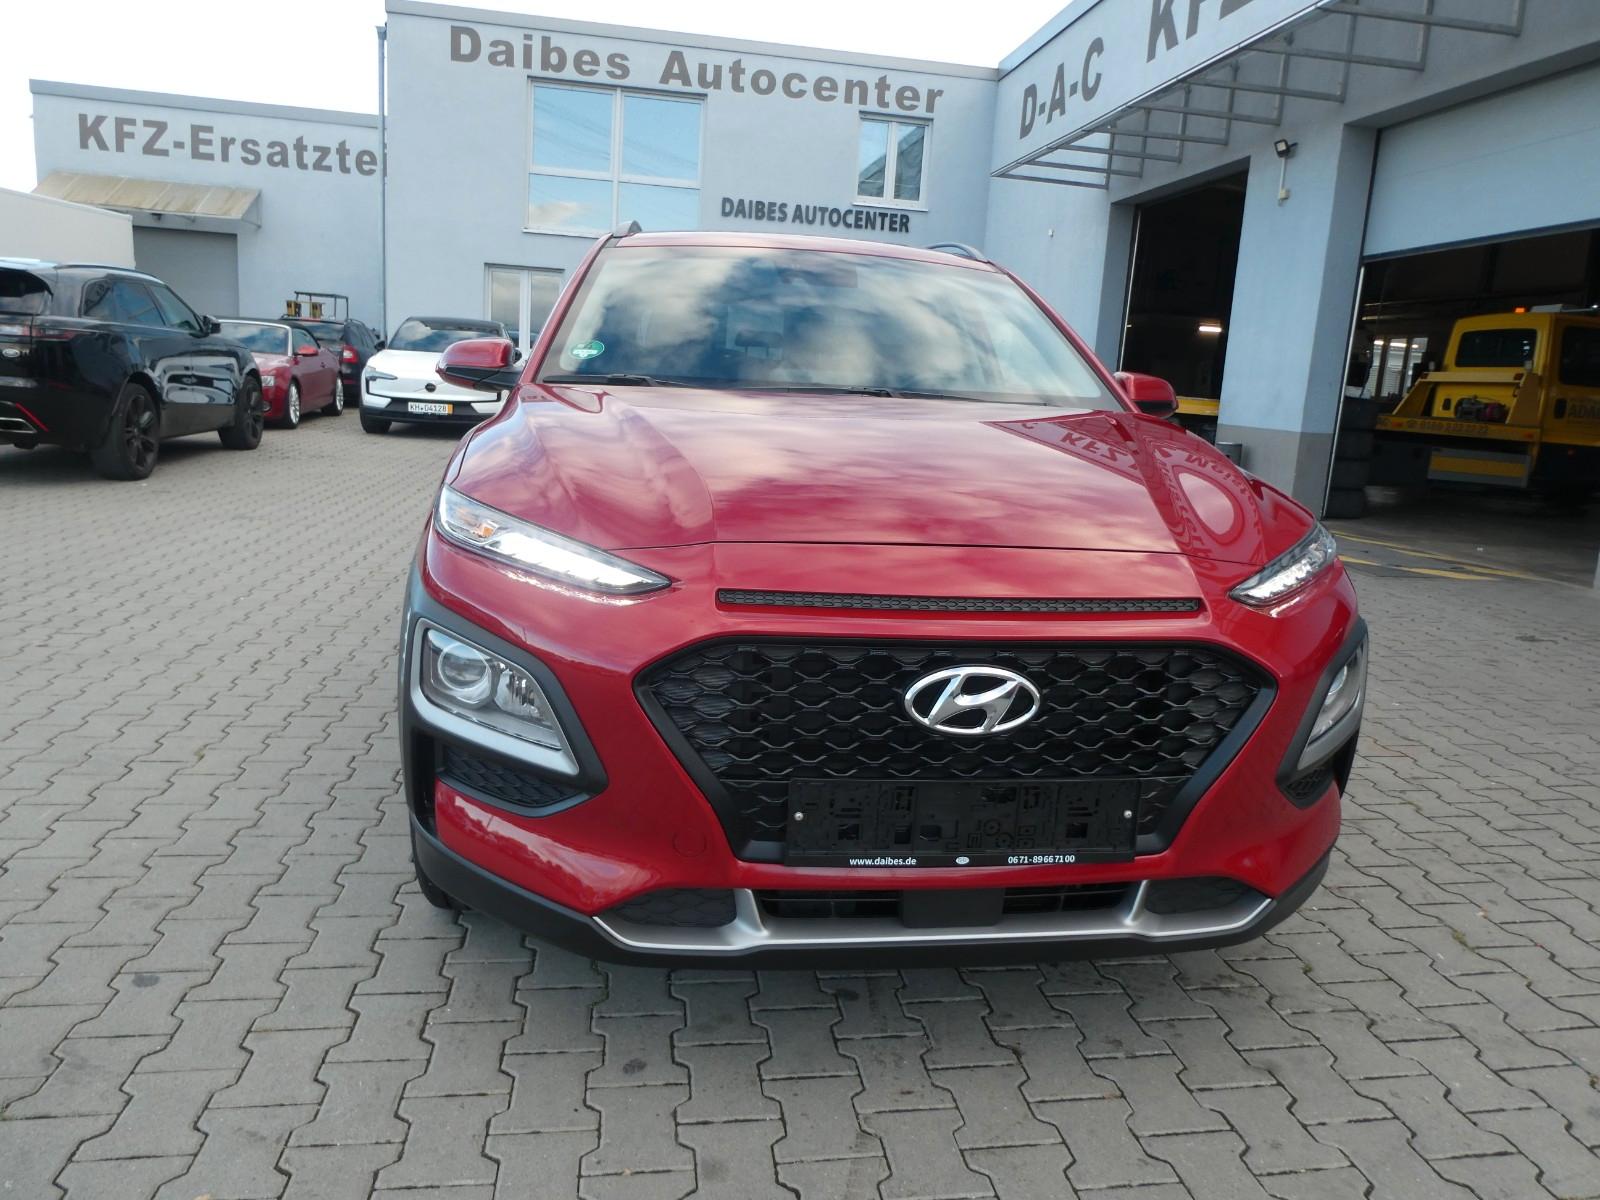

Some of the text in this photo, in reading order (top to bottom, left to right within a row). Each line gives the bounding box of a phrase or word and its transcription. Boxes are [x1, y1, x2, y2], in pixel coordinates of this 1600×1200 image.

[450, 24, 944, 114] Daibes Autocenter
[1019, 36, 1104, 140] D-A-C
[721, 196, 910, 234] DAIBES AUTOCENTER
[849, 855, 1076, 867] www.daibes.de 0671-89667100
